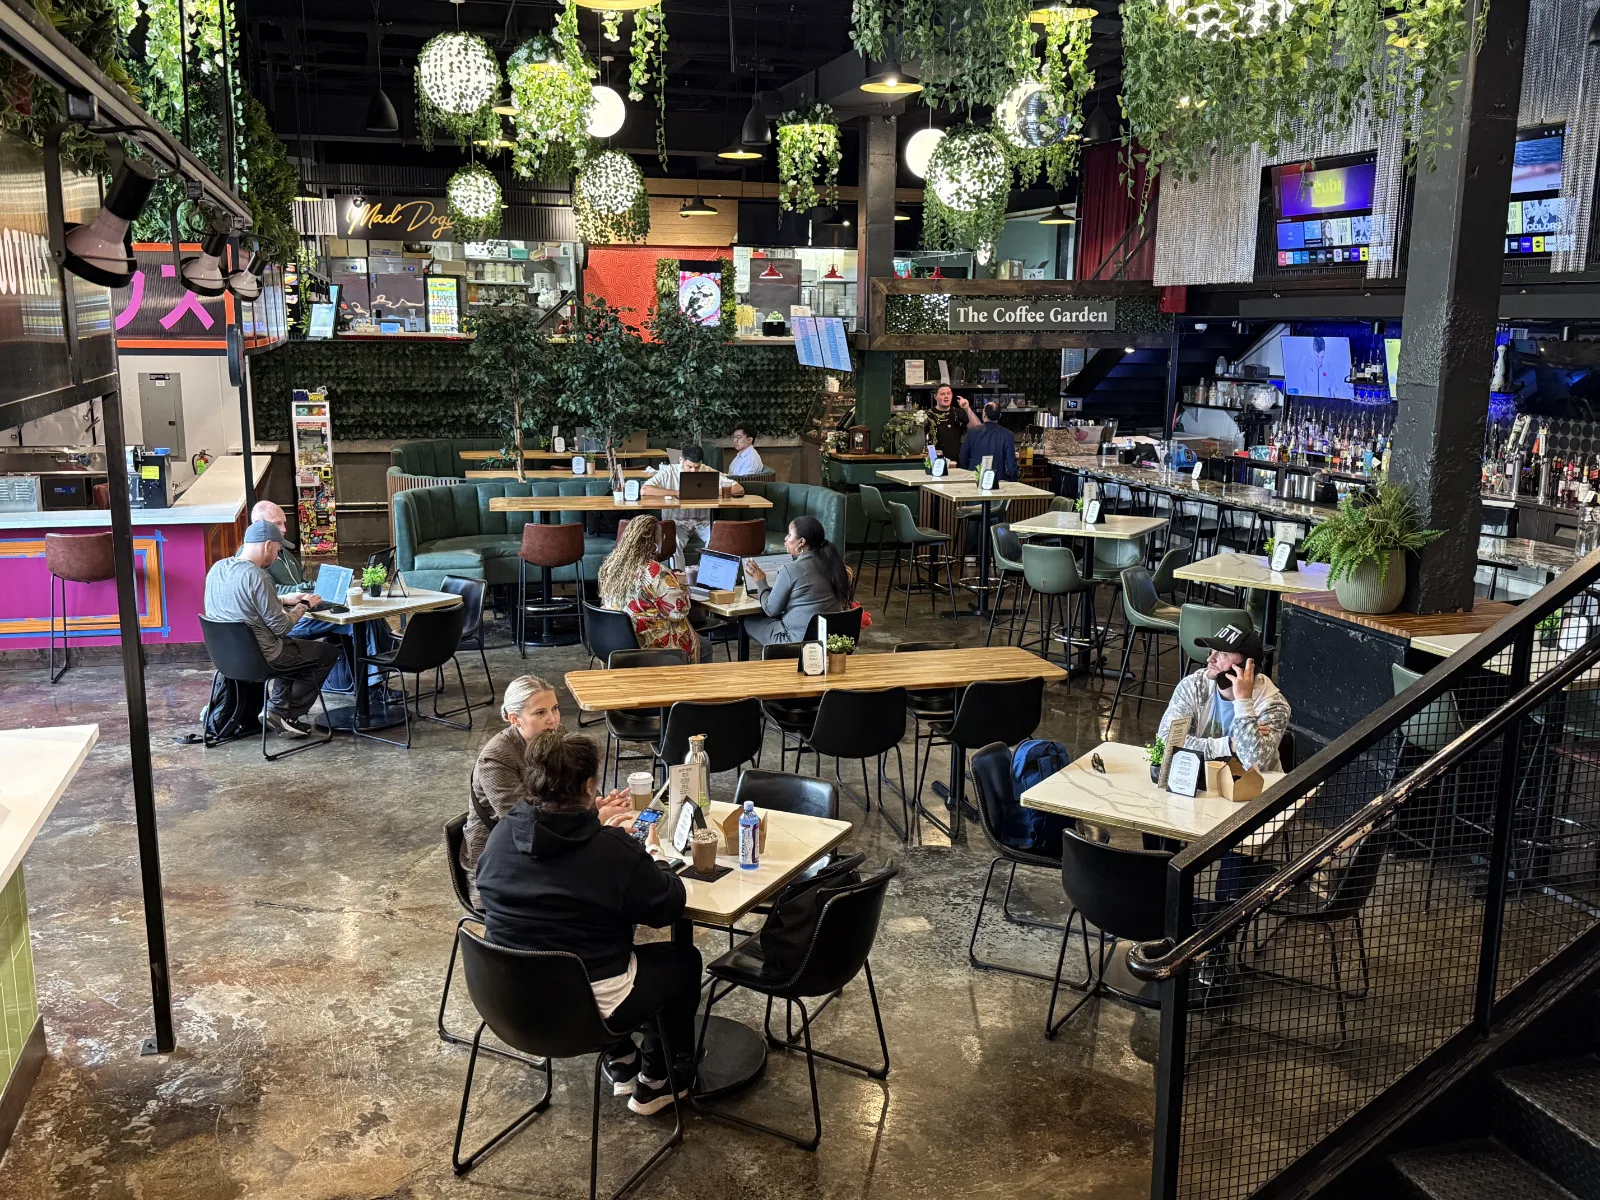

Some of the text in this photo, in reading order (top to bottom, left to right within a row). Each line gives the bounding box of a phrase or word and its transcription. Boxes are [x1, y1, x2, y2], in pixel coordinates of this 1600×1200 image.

[346, 203, 402, 235] Mad
[957, 306, 1107, 322] The Coffee Garden
